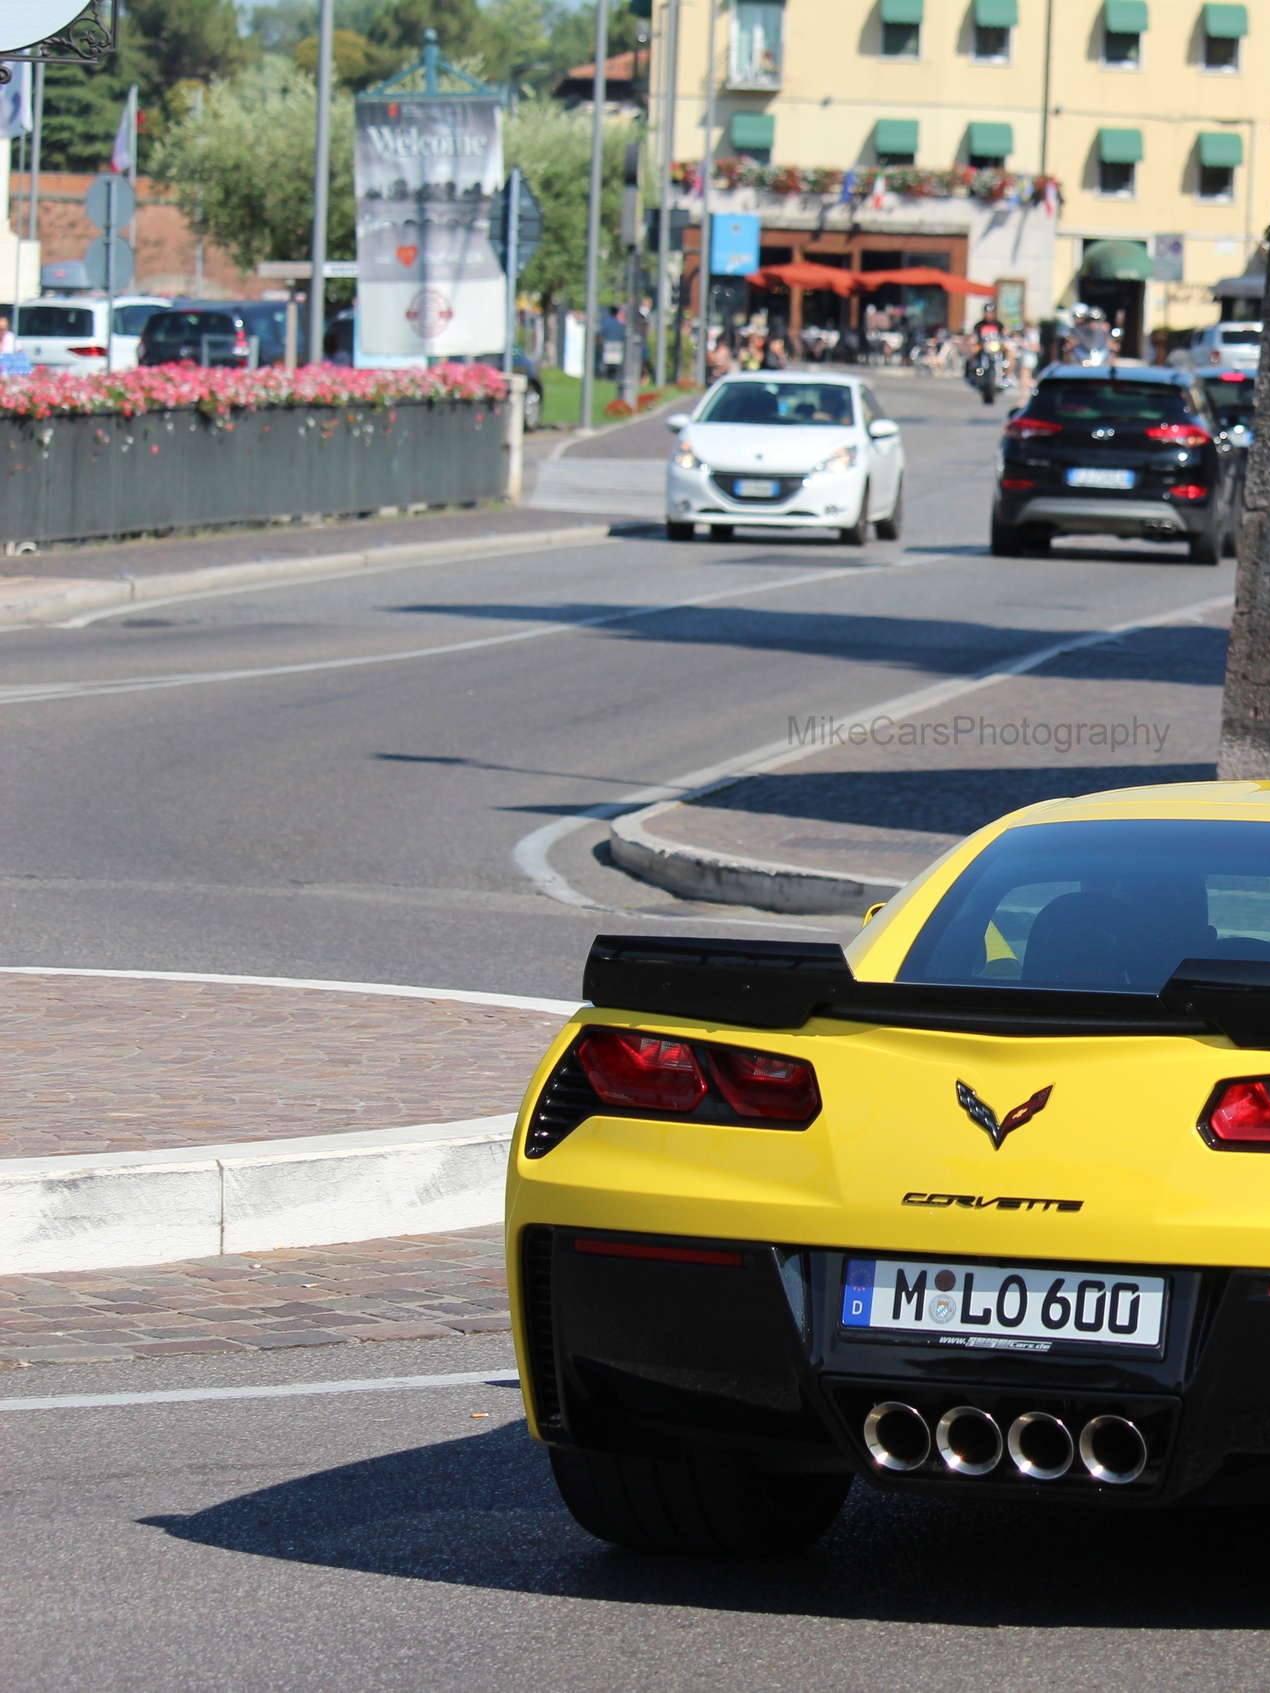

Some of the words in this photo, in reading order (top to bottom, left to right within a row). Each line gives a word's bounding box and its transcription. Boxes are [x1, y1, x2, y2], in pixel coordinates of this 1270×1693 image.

[367, 125, 488, 157] Welcome
[901, 1192, 1085, 1212] CORVETTE
[851, 1299, 864, 1316] D
[892, 1268, 928, 1322] M
[960, 1272, 1029, 1328] LO
[1040, 1277, 1141, 1335] 600
